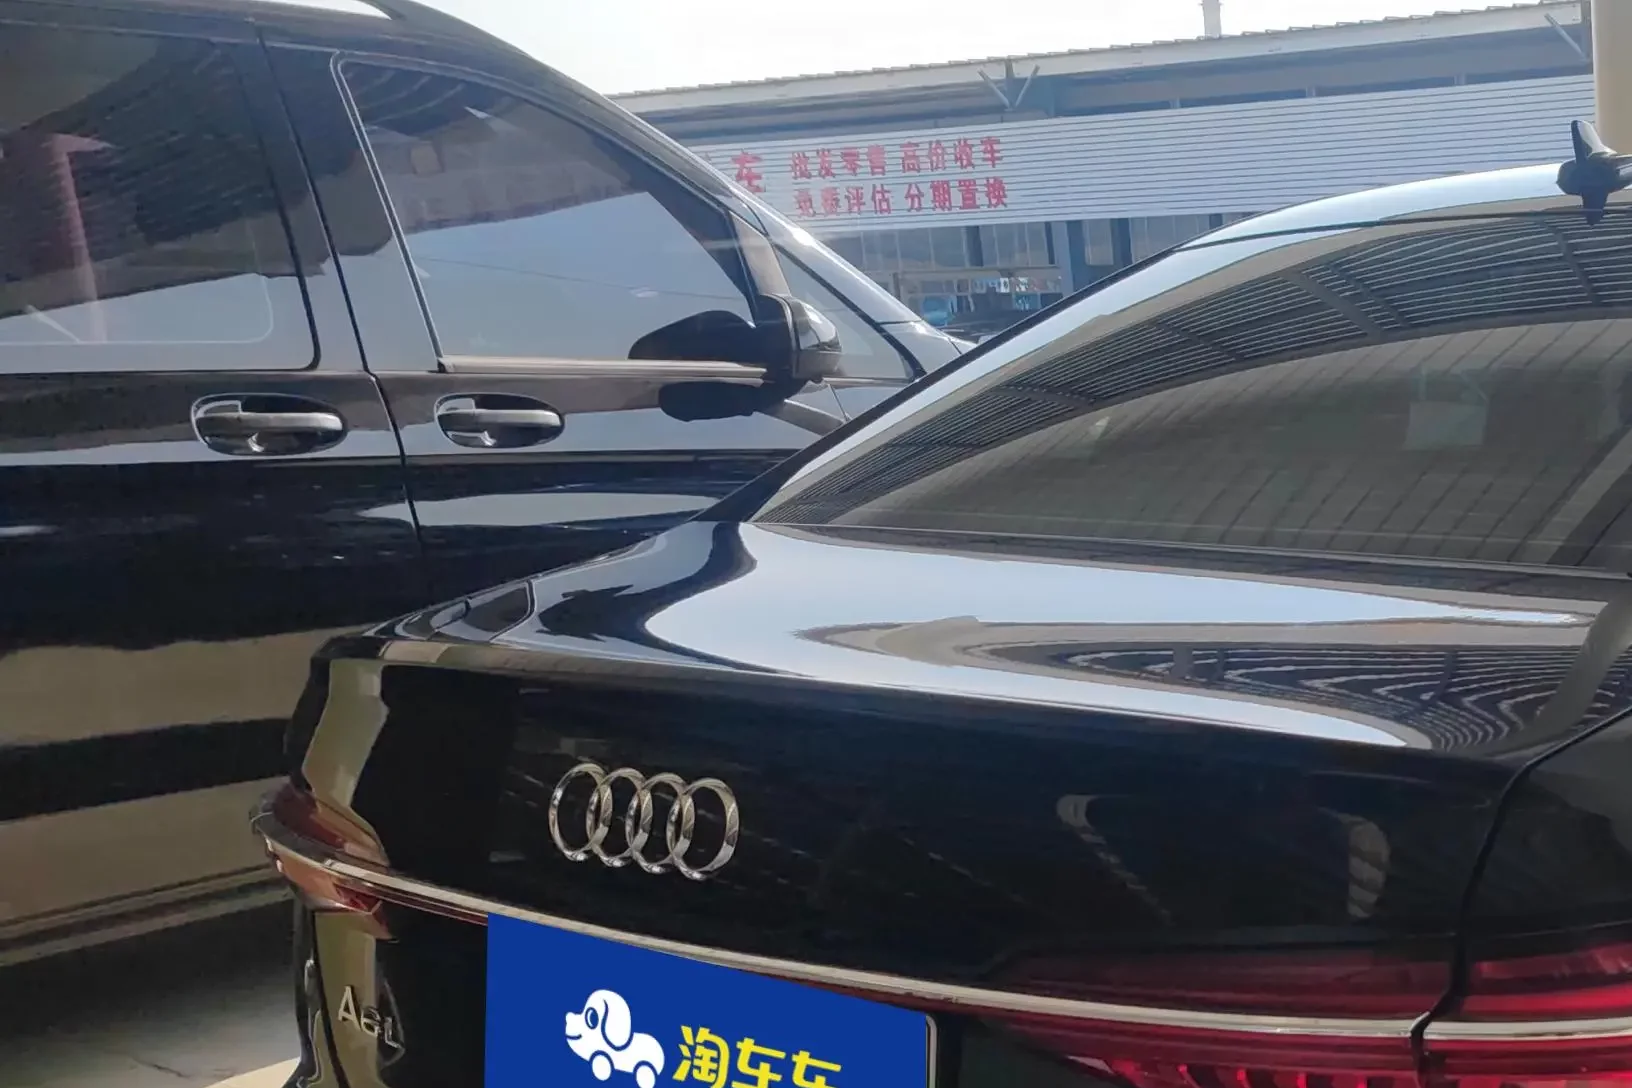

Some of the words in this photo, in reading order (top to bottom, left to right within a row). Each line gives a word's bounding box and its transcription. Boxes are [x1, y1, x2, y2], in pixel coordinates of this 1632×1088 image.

[899, 135, 1003, 173] 高价收车
[904, 176, 1008, 213] 分期置换
